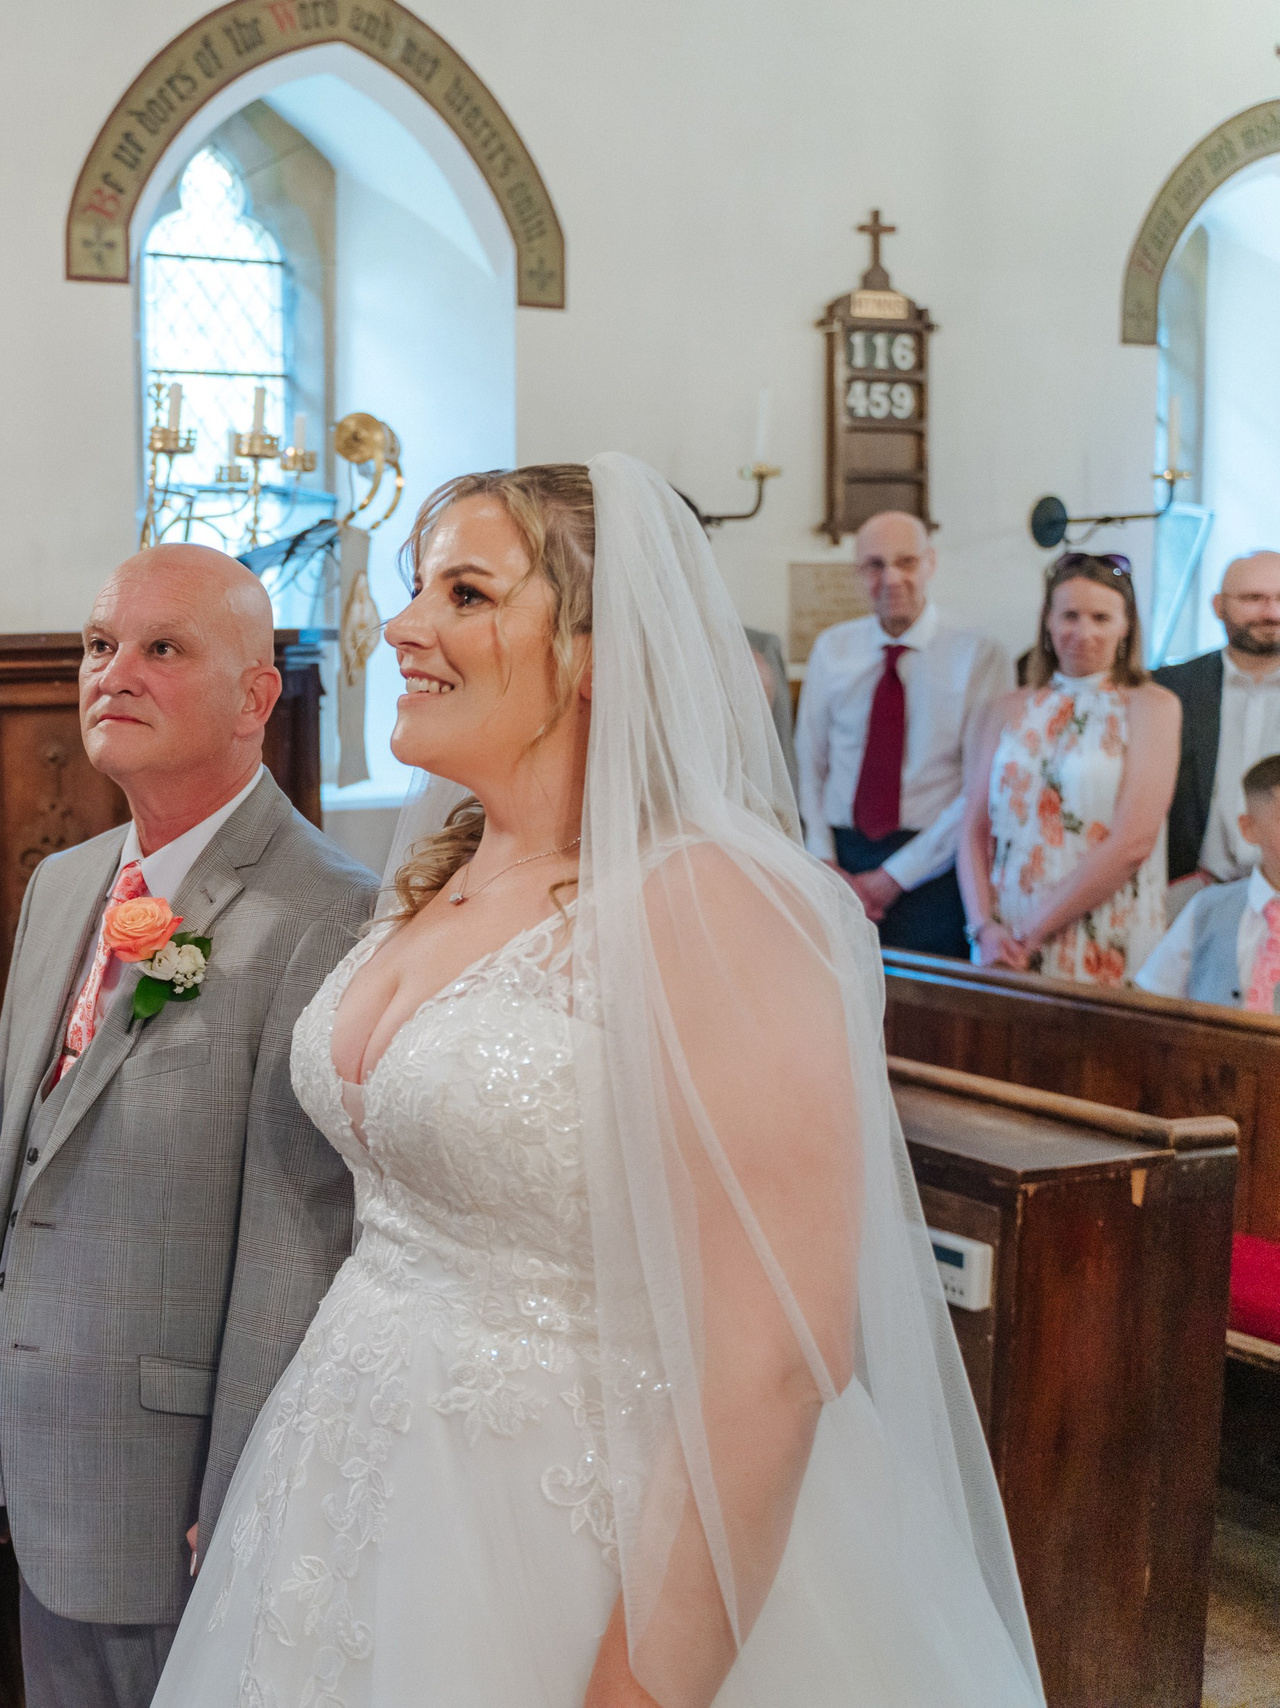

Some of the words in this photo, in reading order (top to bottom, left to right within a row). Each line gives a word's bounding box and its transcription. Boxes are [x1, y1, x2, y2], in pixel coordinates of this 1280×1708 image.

[194, 35, 223, 79] of
[850, 331, 916, 370] 116
[847, 380, 915, 419] 459
